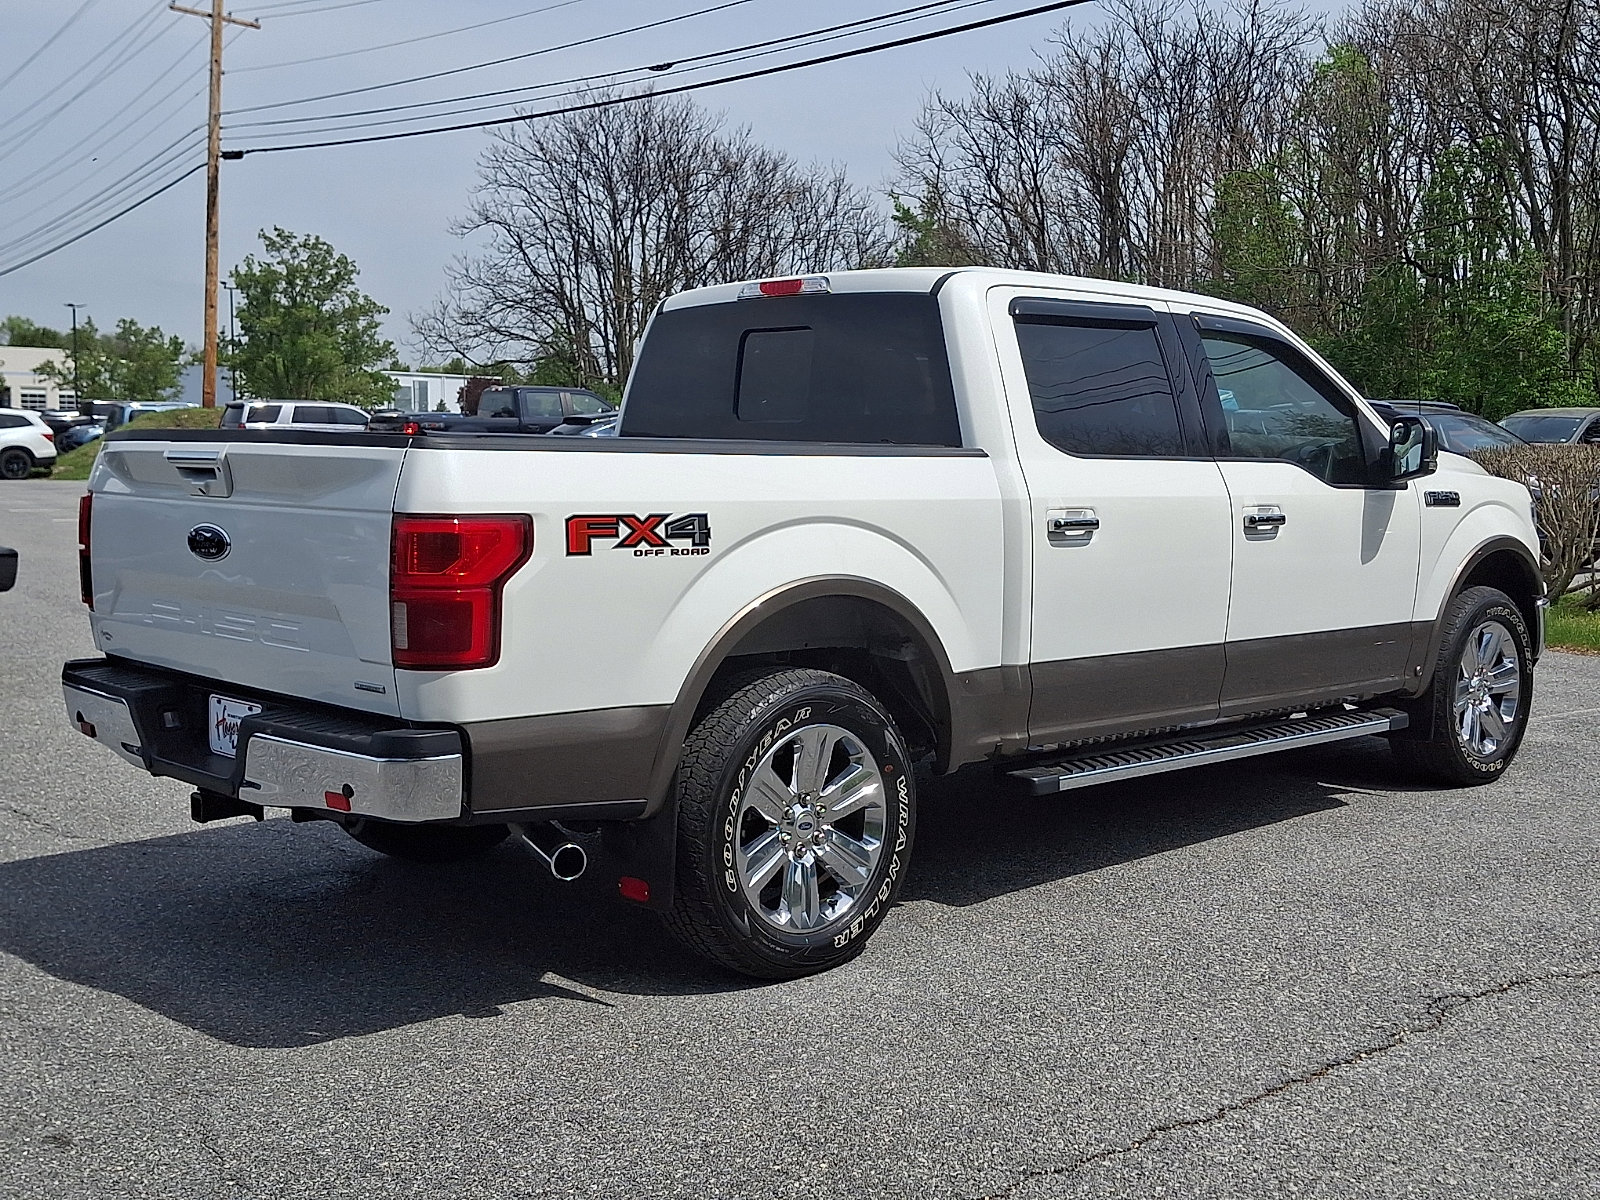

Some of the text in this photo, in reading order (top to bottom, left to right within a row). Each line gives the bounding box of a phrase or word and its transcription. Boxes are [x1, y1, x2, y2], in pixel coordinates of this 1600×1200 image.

[565, 513, 711, 556] FX4
[633, 548, 710, 557] OFF ROAD
[723, 706, 812, 893] GOODYEAR
[833, 774, 909, 949] WRANGLER
